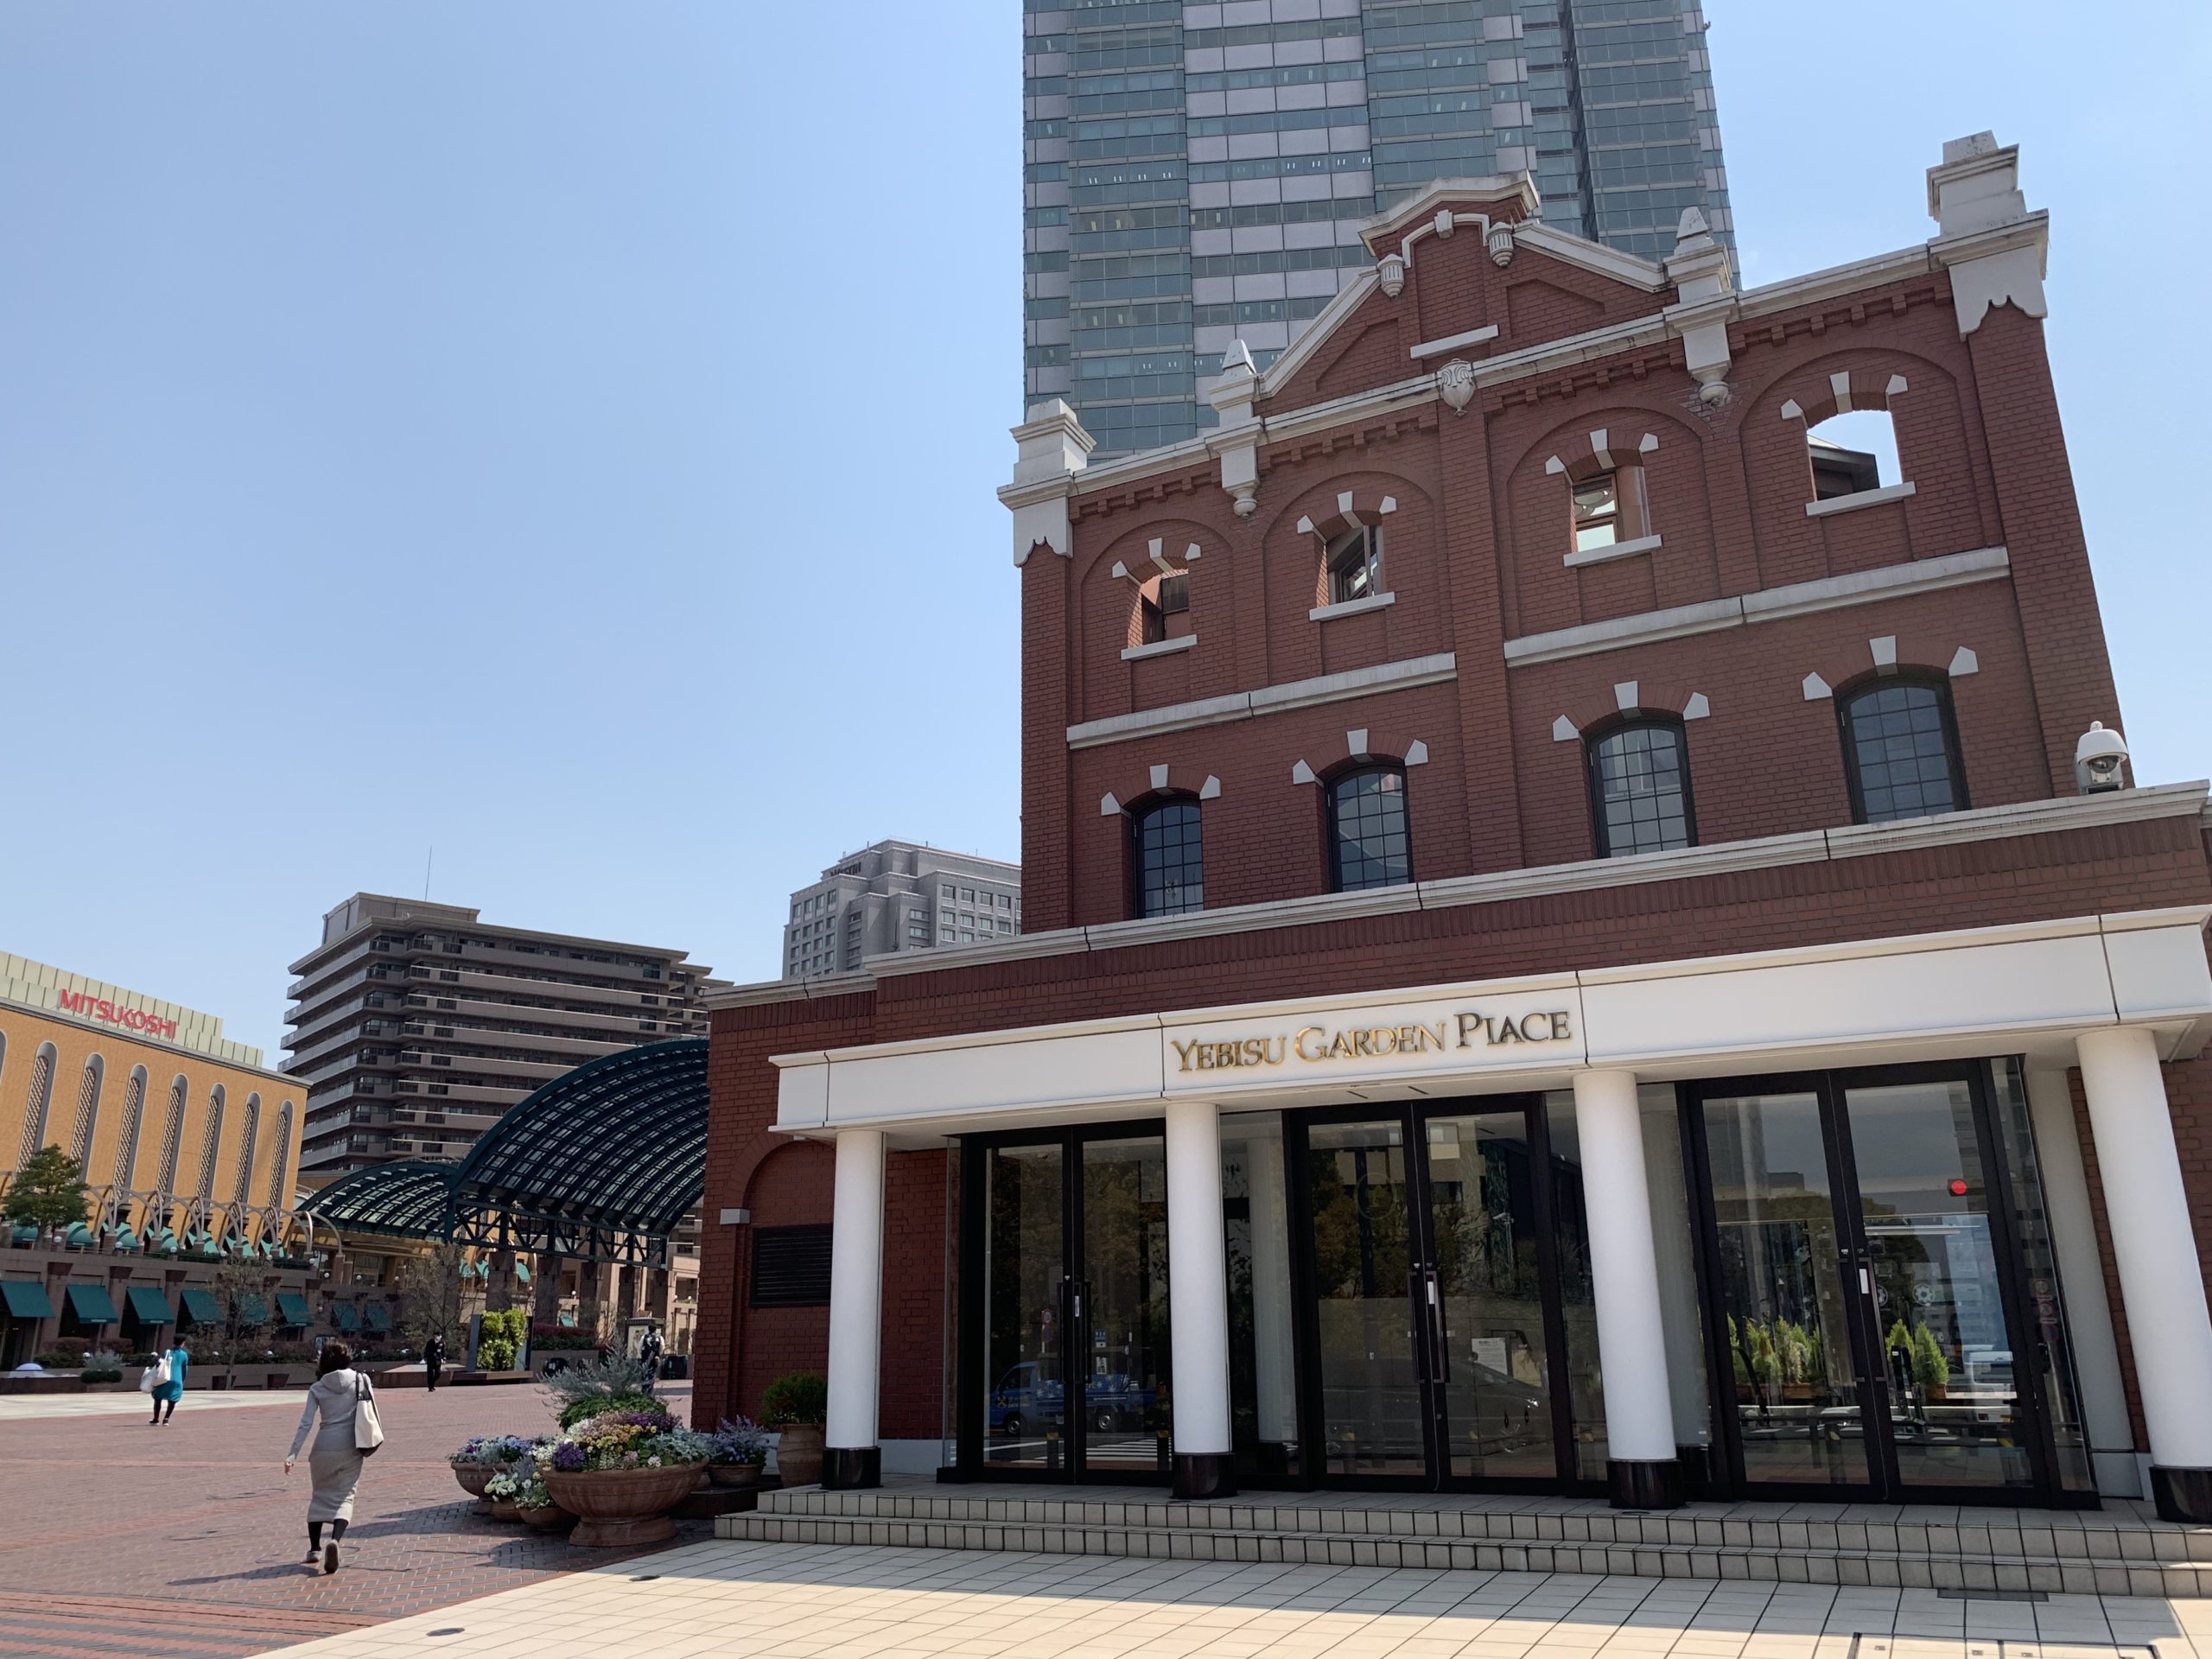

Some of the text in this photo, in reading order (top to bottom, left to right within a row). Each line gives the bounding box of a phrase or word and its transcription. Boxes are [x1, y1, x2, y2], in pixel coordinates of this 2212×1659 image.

[60, 988, 177, 1039] MITSUKOSHI
[1170, 1011, 1572, 1071] YEBISU GARDEN PLACE
